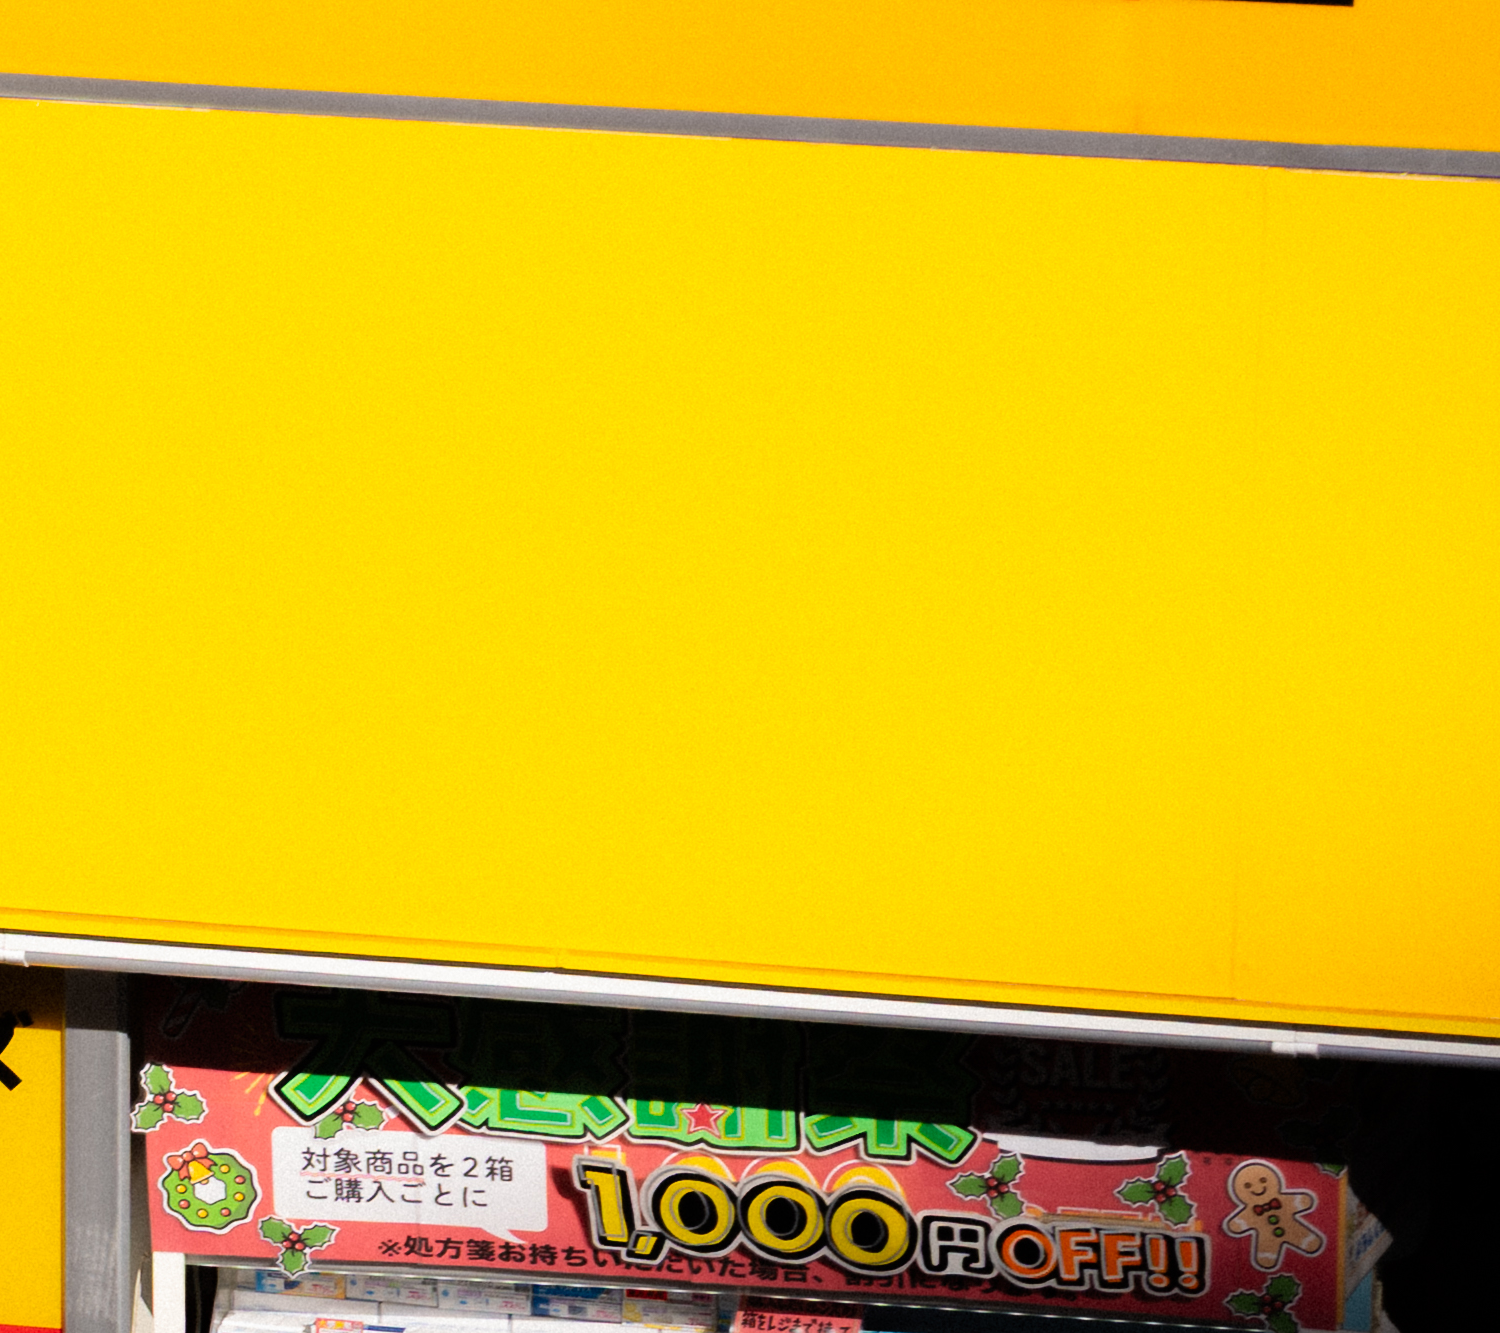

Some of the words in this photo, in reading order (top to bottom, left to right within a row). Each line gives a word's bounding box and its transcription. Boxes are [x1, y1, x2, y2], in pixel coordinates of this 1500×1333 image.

[306, 1177, 488, 1209] ご購入ごとに
